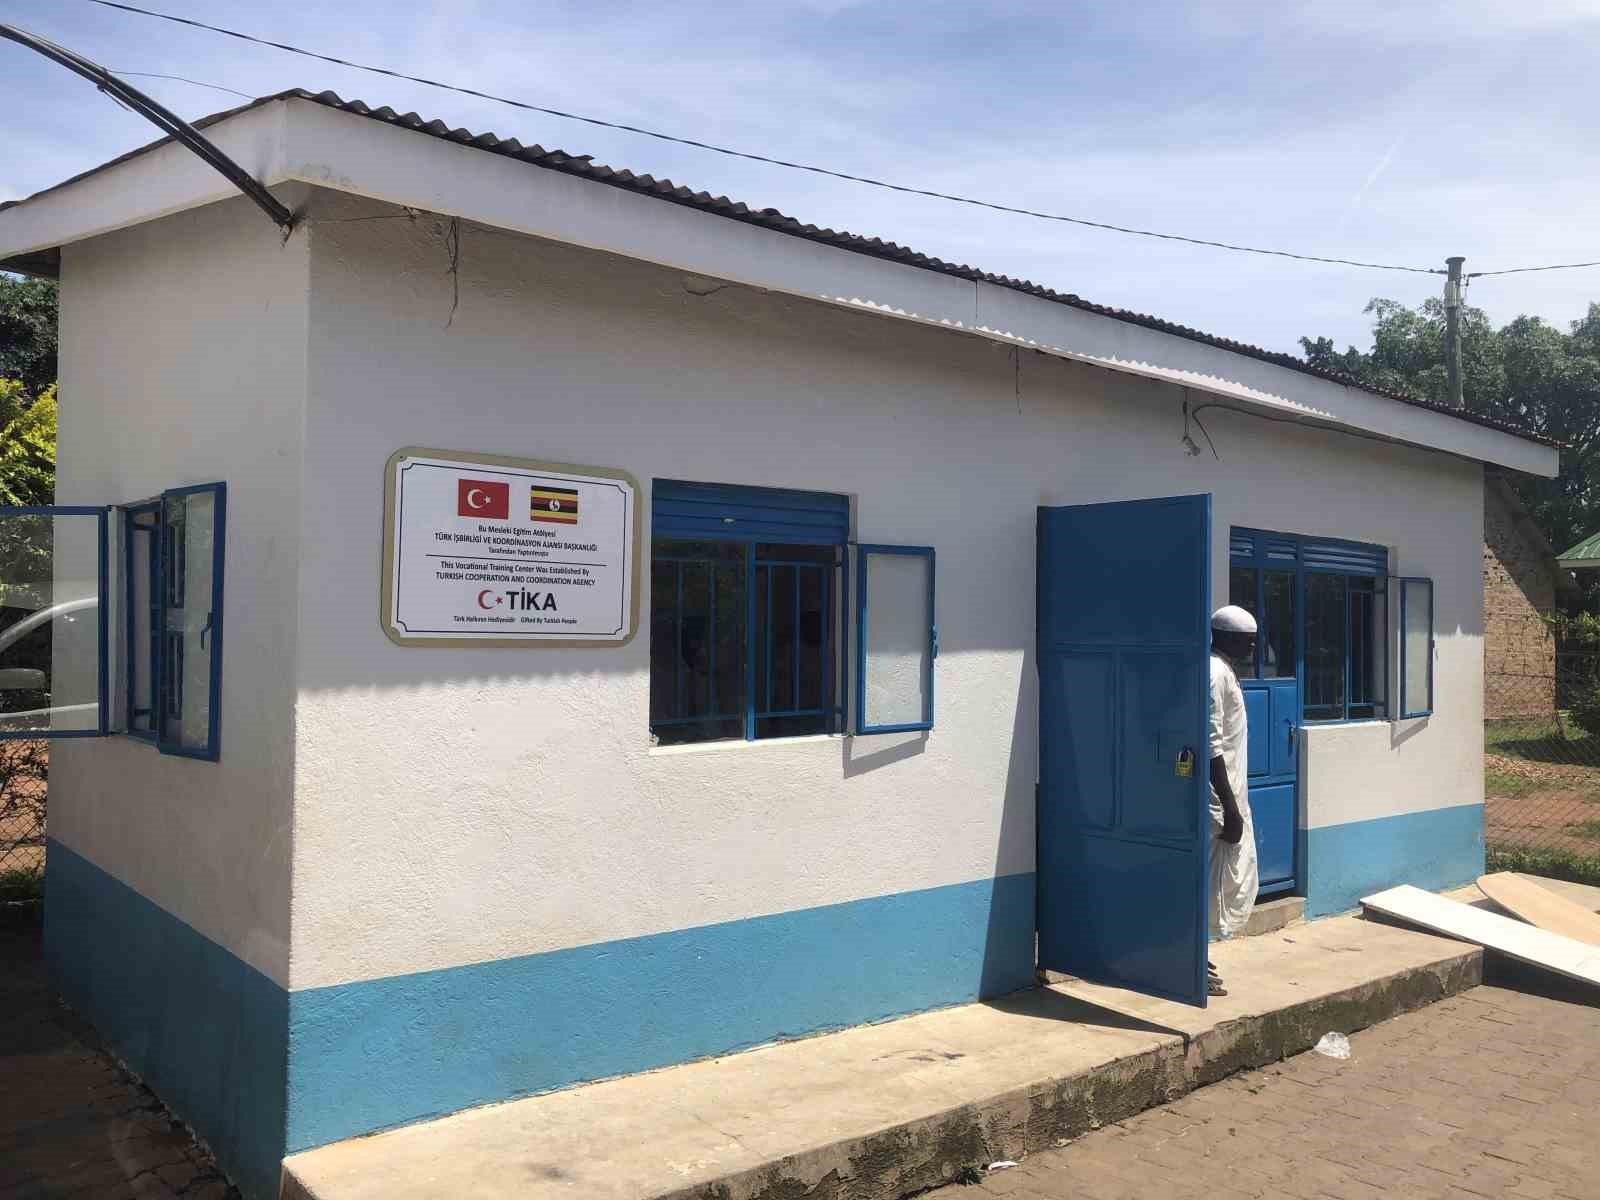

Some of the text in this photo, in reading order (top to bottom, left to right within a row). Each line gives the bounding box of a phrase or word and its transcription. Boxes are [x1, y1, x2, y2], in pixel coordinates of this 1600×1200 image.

[478, 525, 487, 533] Bu
[488, 525, 512, 534] Mesleki
[435, 532, 452, 541] TÜRK
[483, 536, 491, 544] VE
[542, 541, 563, 549] AJANSI
[441, 561, 454, 569] This
[455, 561, 489, 570] Vocational
[489, 563, 514, 573] Training
[515, 564, 535, 573] Center
[549, 566, 582, 575] Established
[583, 569, 590, 577] By
[435, 571, 596, 586] TURKISH COOPERATION AND COORDINATION AGENCY
[505, 587, 557, 611] TİKA
[453, 615, 465, 623] Türk
[520, 616, 535, 624] Gifted
[536, 617, 543, 625] By
